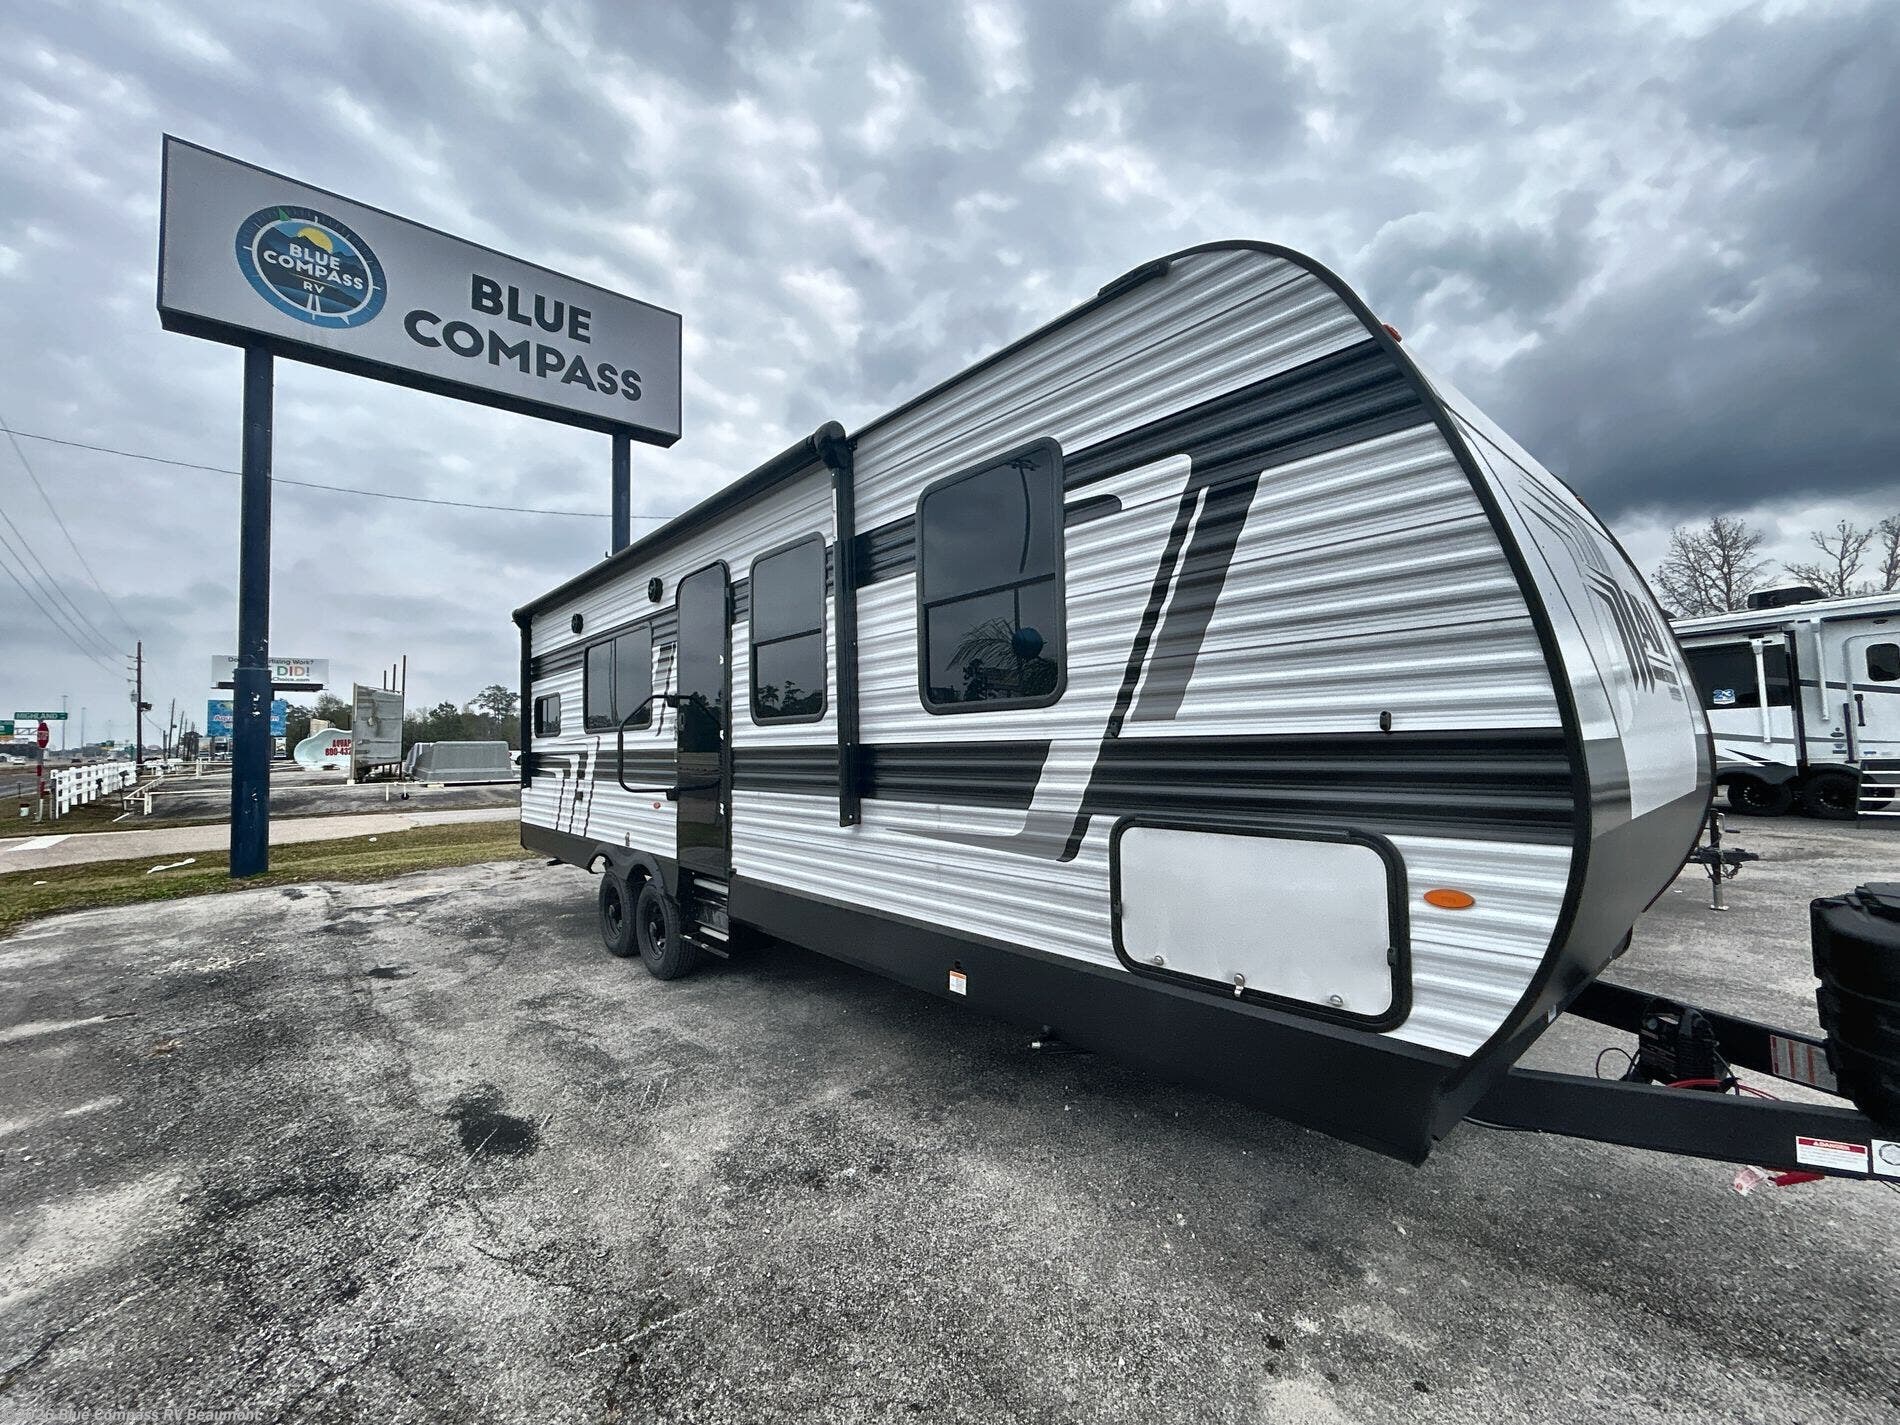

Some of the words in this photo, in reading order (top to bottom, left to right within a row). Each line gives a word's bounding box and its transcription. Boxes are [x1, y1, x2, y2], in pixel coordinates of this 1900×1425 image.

[263, 250, 363, 289] COMPASS
[289, 243, 340, 270] BLUE
[303, 281, 325, 294] RV
[471, 273, 591, 344] BLUE
[404, 310, 642, 401] COMPASS
[277, 666, 310, 677] DID!
